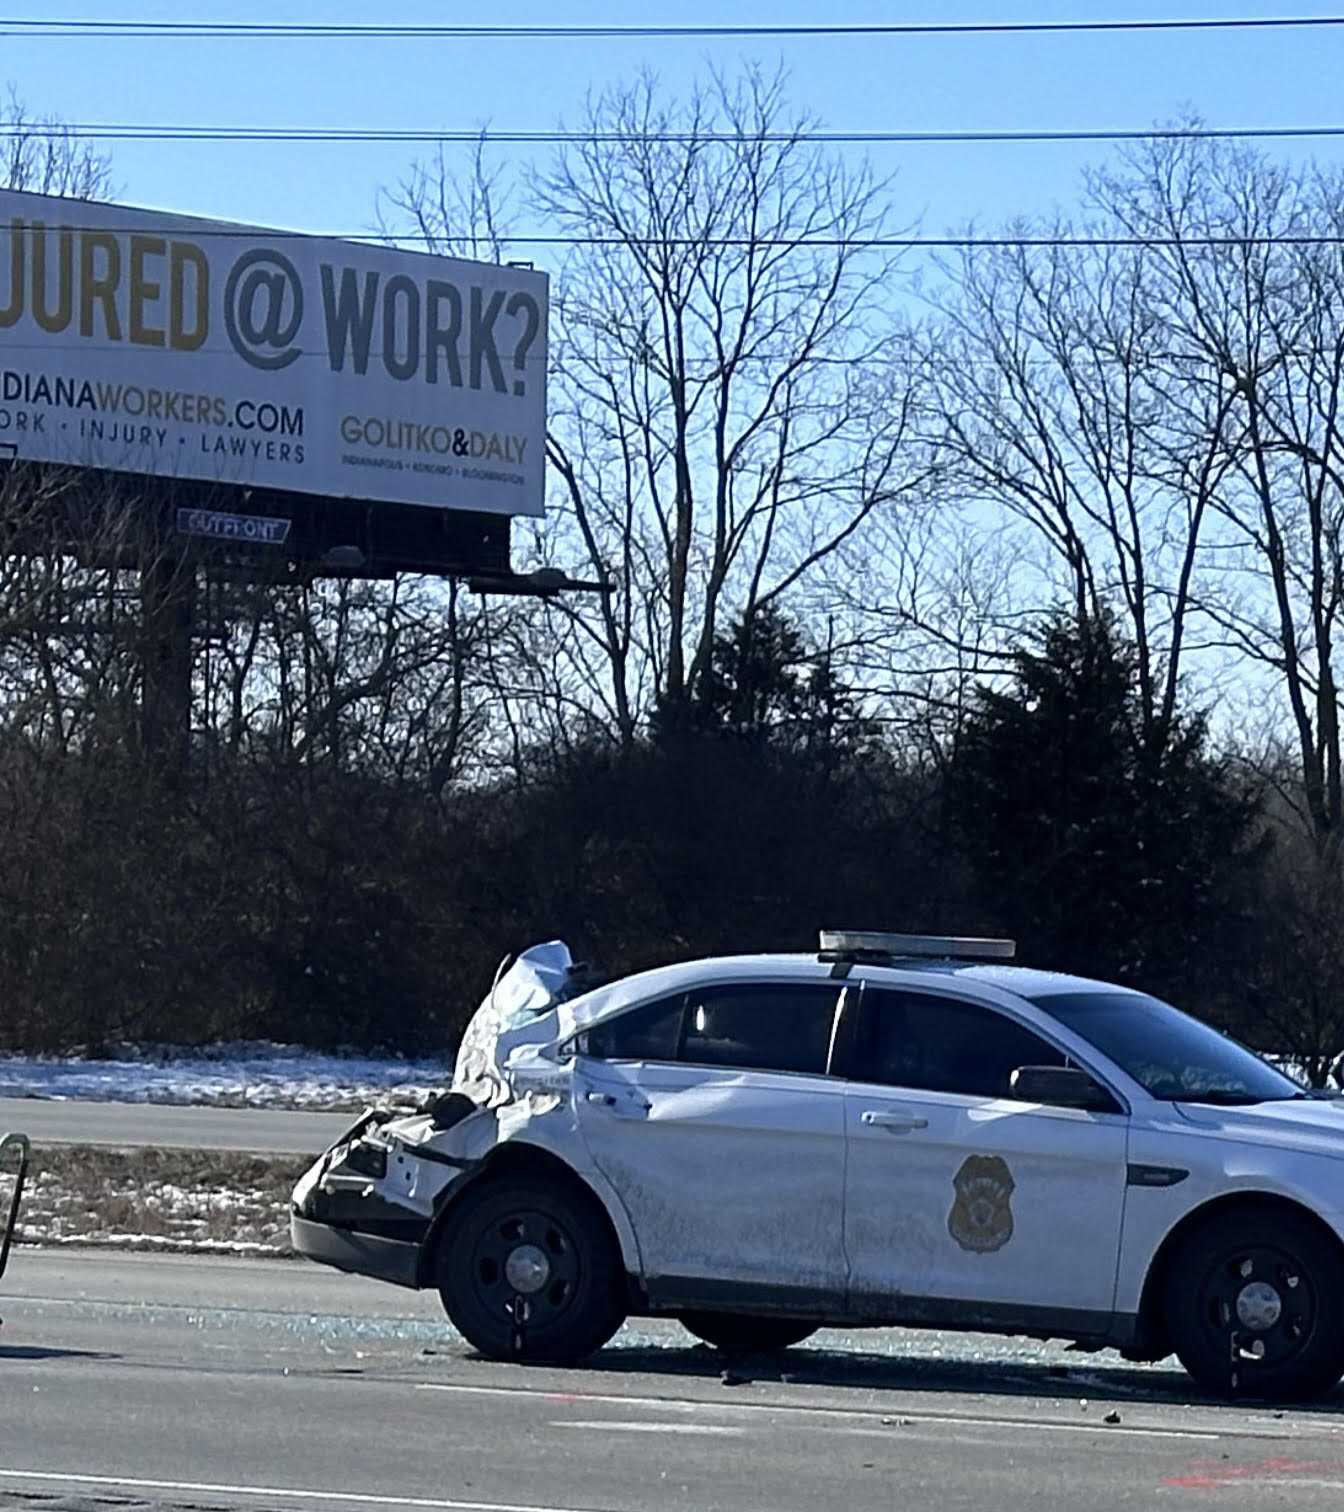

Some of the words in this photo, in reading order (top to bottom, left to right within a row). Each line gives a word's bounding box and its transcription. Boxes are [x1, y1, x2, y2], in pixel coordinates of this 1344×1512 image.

[0, 217, 211, 350] JURED
[222, 247, 304, 372] @
[318, 262, 539, 397] WORK?
[3, 370, 304, 437] DIANAWORKERS.COM
[79, 418, 168, 449] INJURY
[200, 432, 306, 464] LAWYERS
[340, 414, 528, 465] GOLITKO&DALY
